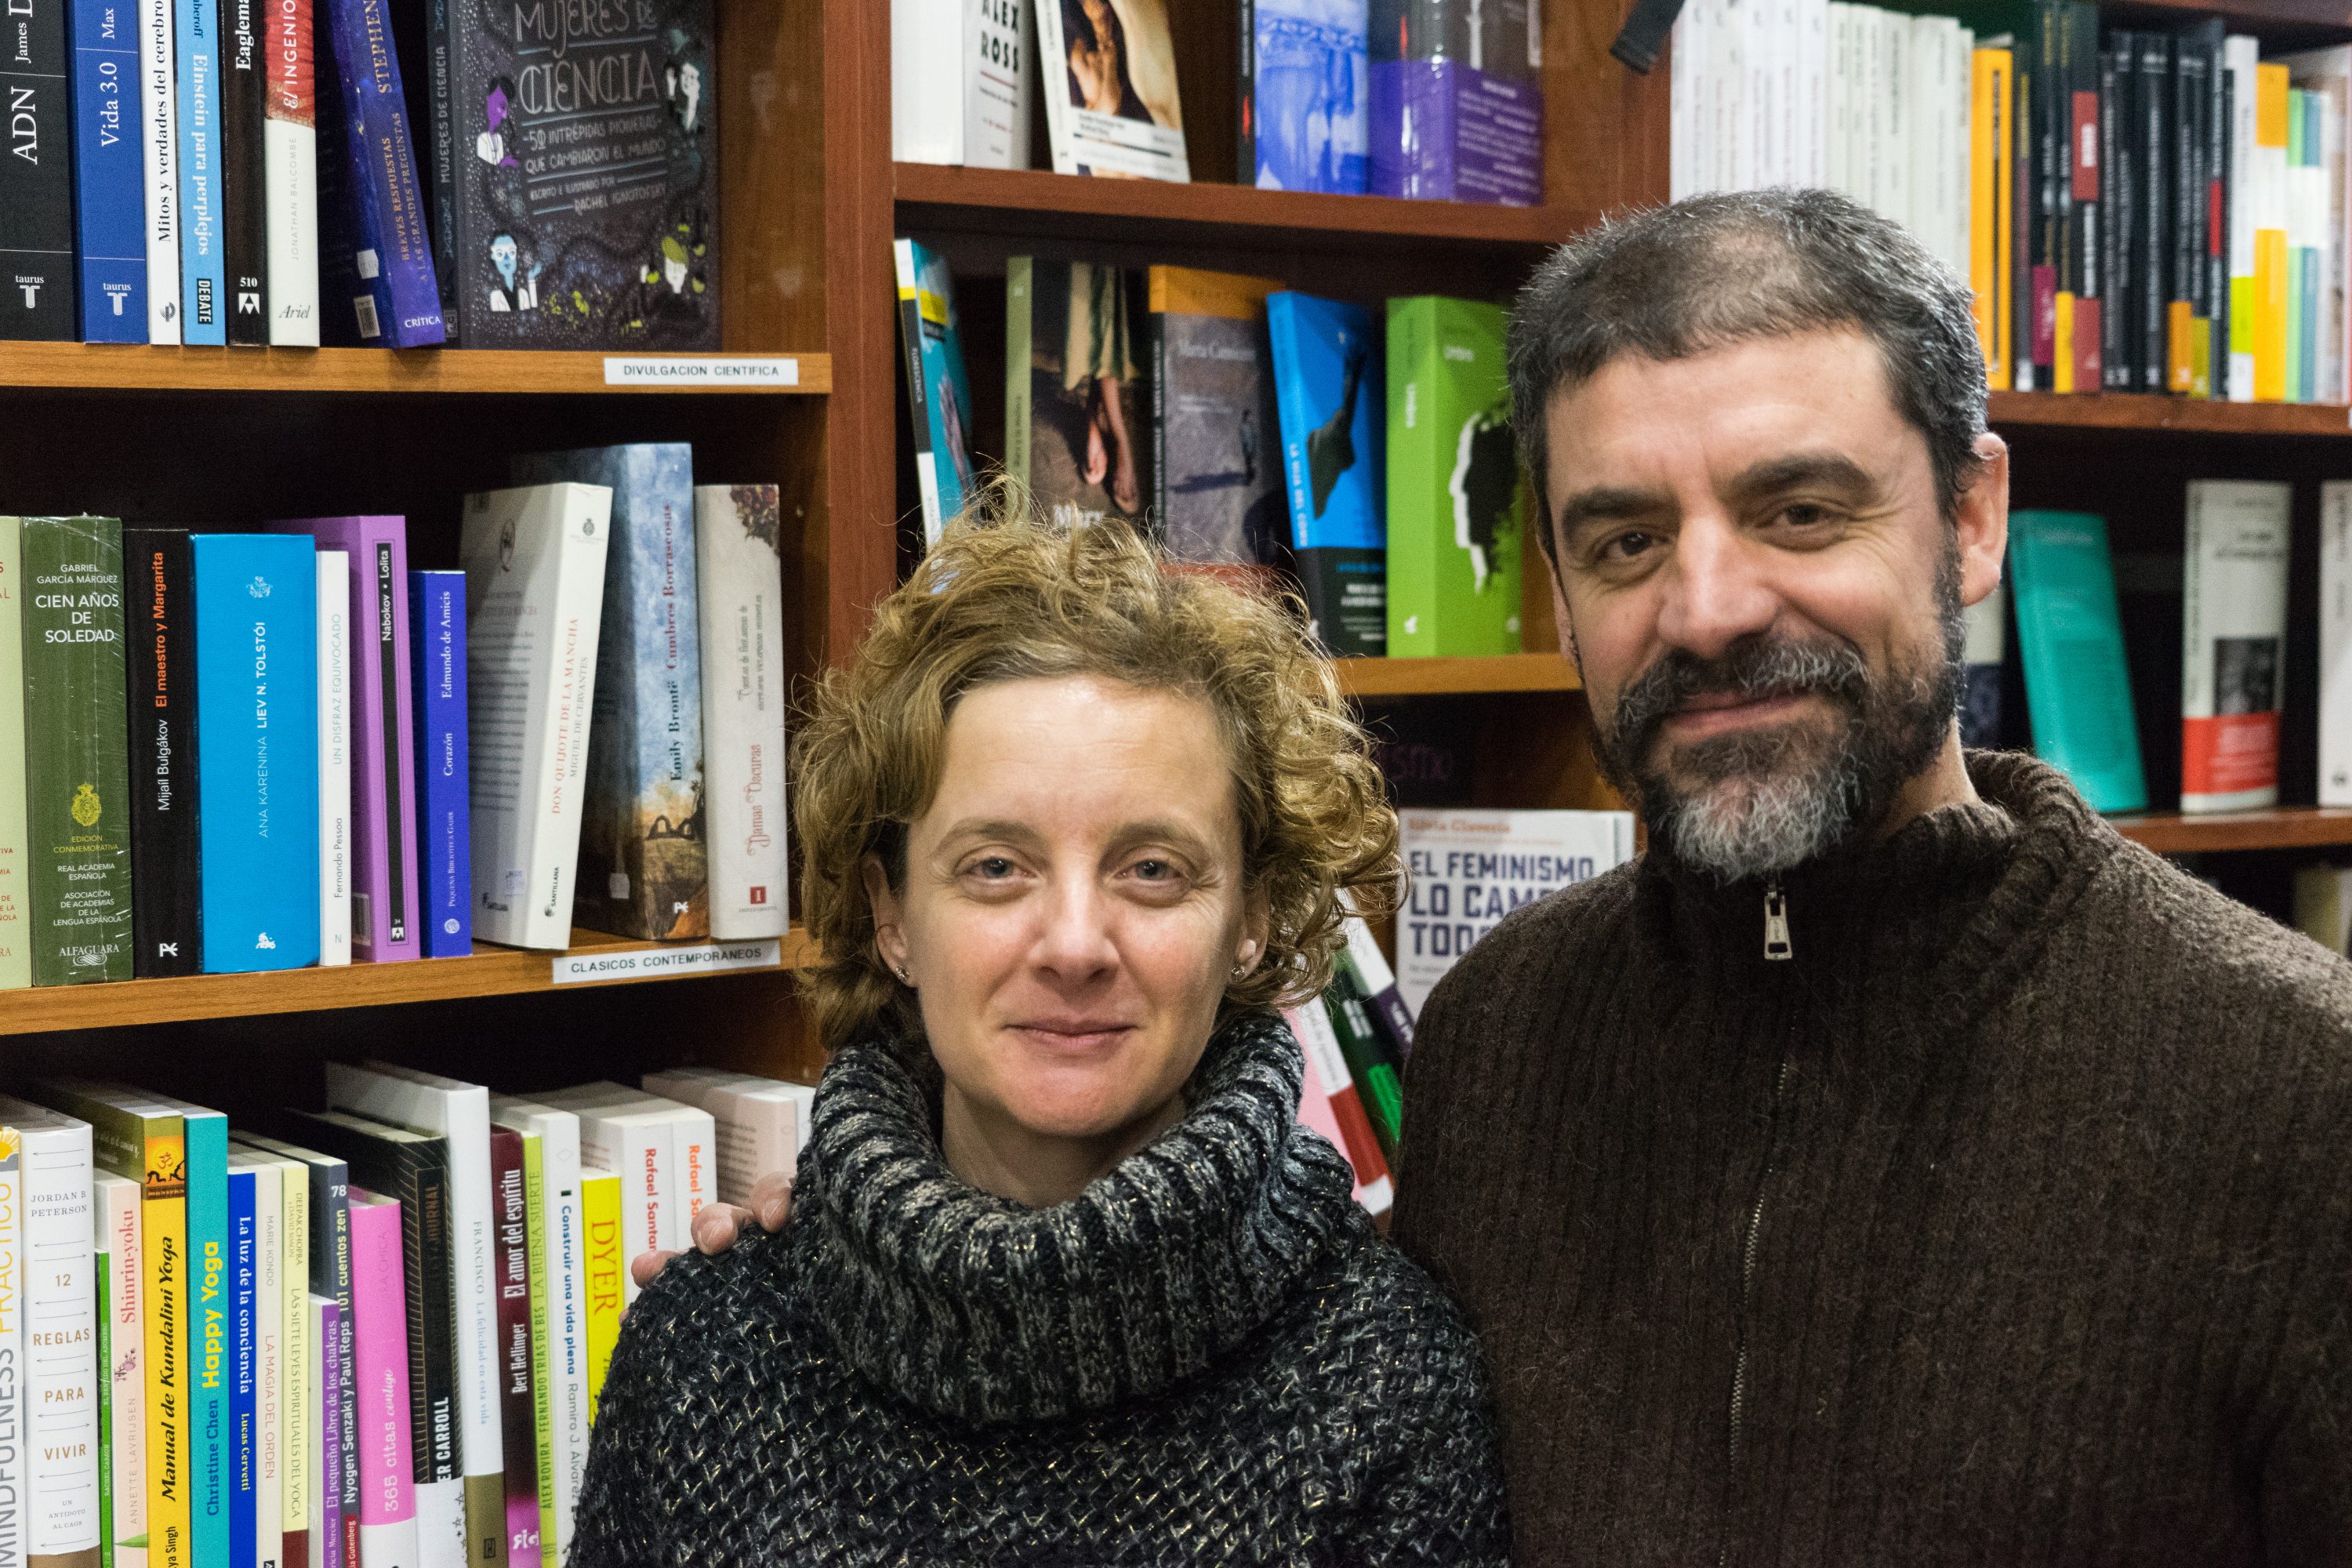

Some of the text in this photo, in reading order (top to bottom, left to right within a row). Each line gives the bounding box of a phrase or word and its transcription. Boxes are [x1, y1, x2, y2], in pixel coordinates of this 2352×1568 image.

[101, 8, 115, 39] Max
[364, 0, 392, 94] STEPHEN
[515, 0, 630, 58] MUJERES
[982, 31, 1018, 74] ROSS
[100, 62, 120, 147] Vida 3.0
[519, 49, 659, 114] CIENCIA
[11, 85, 38, 165] ADN
[152, 2, 172, 242] Mitos y verdades del cerebro
[436, 45, 452, 183] MUJERES DE CIENCIA
[191, 55, 212, 256] Einstein para perplejos
[525, 156, 546, 175] QUE
[550, 147, 610, 169] CAMBIARON
[15, 274, 45, 284] taurus
[103, 281, 132, 291] taurus
[198, 279, 212, 324] DEBATE
[239, 277, 258, 289] 510
[279, 304, 310, 319] Ariel
[404, 315, 441, 328] CRÍTICA
[623, 365, 779, 377] DIVULGACION CIENTIFICA
[35, 592, 119, 608] CIEN AÑOS
[37, 573, 118, 584] GARCÍA MÁRQUEZ
[153, 552, 166, 619] Margarita
[379, 550, 392, 641] Nabokov Lolita
[45, 629, 115, 643] SOLEDAD
[71, 612, 92, 624] DE
[155, 636, 167, 691] maestro
[441, 590, 452, 699] Edmundo de Amicis
[662, 504, 684, 781] Emily Brontë Cumbres Borrascosas
[155, 695, 167, 707] El
[332, 613, 342, 764] UN DISFRAZ EQUIVOCADO
[254, 621, 268, 837] ANA KARENINA LIEV N. TOLSTÓI
[443, 732, 453, 776] Corazón
[53, 844, 118, 853] CONMEMORATIVA
[333, 817, 343, 898] Fernando Pessoa
[1410, 850, 1595, 883] EL FEMINISMO
[64, 889, 111, 899] ASOCIACIÓN
[69, 872, 107, 880] ESPAÑOLA
[1410, 883, 1450, 917] LO
[85, 915, 122, 924] ESPAÑOLA
[59, 944, 120, 956] ALFAGUARA
[571, 947, 762, 973] CLASICOS CONTEMPORANEOS
[330, 1185, 347, 1197] 78
[645, 1148, 660, 1196] Rafael
[688, 1145, 702, 1193] Rafael
[31, 1204, 87, 1217] PETERSON
[500, 1168, 526, 1298] El amor del espíritu
[528, 1171, 544, 1301] LA BUENA SUERTE
[56, 1273, 71, 1287] 12
[118, 1210, 139, 1323] Shinrin-yoku
[266, 1254, 274, 1287] KONDO
[561, 1205, 577, 1375] Construir una vida plena
[592, 1219, 618, 1316] DYER
[239, 1216, 252, 1394] La luz de la conciencia
[33, 1328, 90, 1346] REGLAS
[336, 1209, 358, 1504] Nyogen Senzaki y Paul Reps 101 cuentos zen
[510, 1323, 528, 1395] Bert Hellinger
[159, 1236, 179, 1502] Manual de Kundalini Yoga
[201, 1242, 223, 1516] Christine Chen Happy Yoga
[45, 1386, 85, 1403] PARA
[265, 1335, 275, 1479] LA MAGIA DEL ORDEN
[291, 1288, 301, 1519] LAS SIETE LEYES ESPIRITUALES DEL YOGA
[44, 1443, 87, 1461] VIVIR
[241, 1413, 251, 1491] Lucas Cervetti
[434, 1396, 452, 1461] CARROLL
[128, 1397, 138, 1524] ANNETTE LAVRIJSEN
